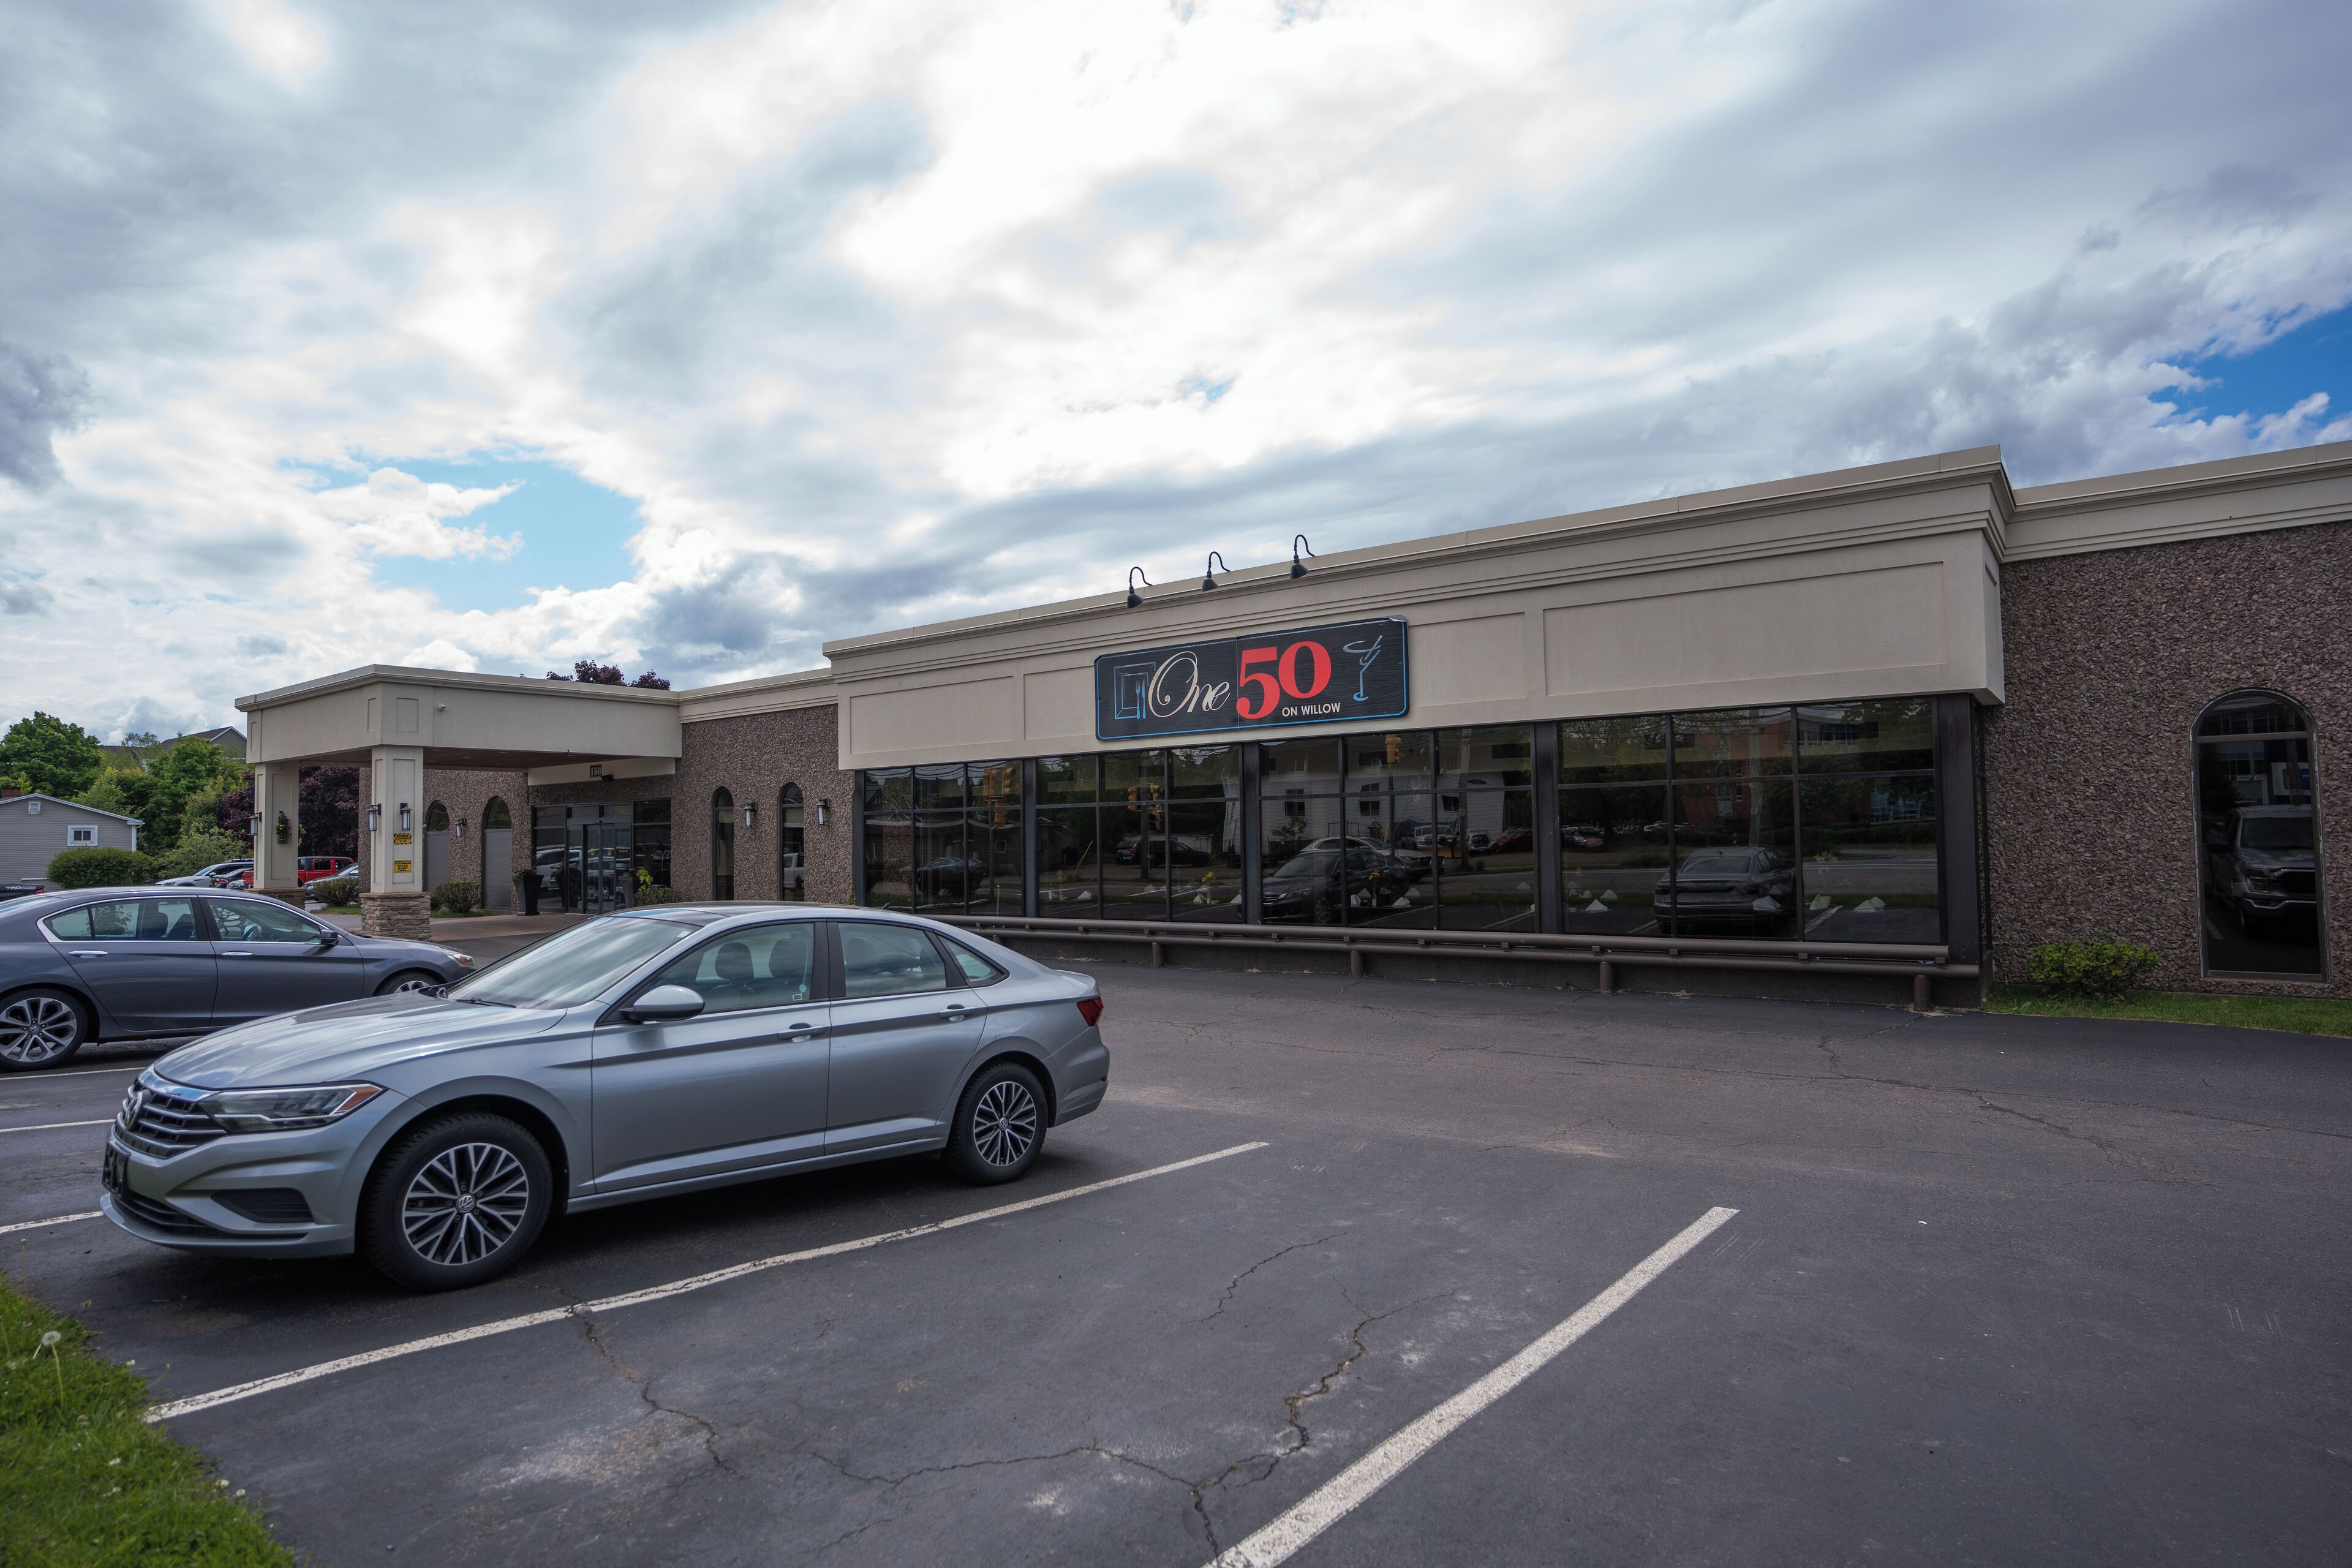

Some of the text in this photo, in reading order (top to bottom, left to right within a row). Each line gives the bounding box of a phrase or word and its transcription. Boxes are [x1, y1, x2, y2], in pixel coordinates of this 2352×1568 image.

[1148, 641, 1332, 720] One 50
[1282, 703, 1341, 717] ON WILLOW
[590, 766, 601, 776] 150
